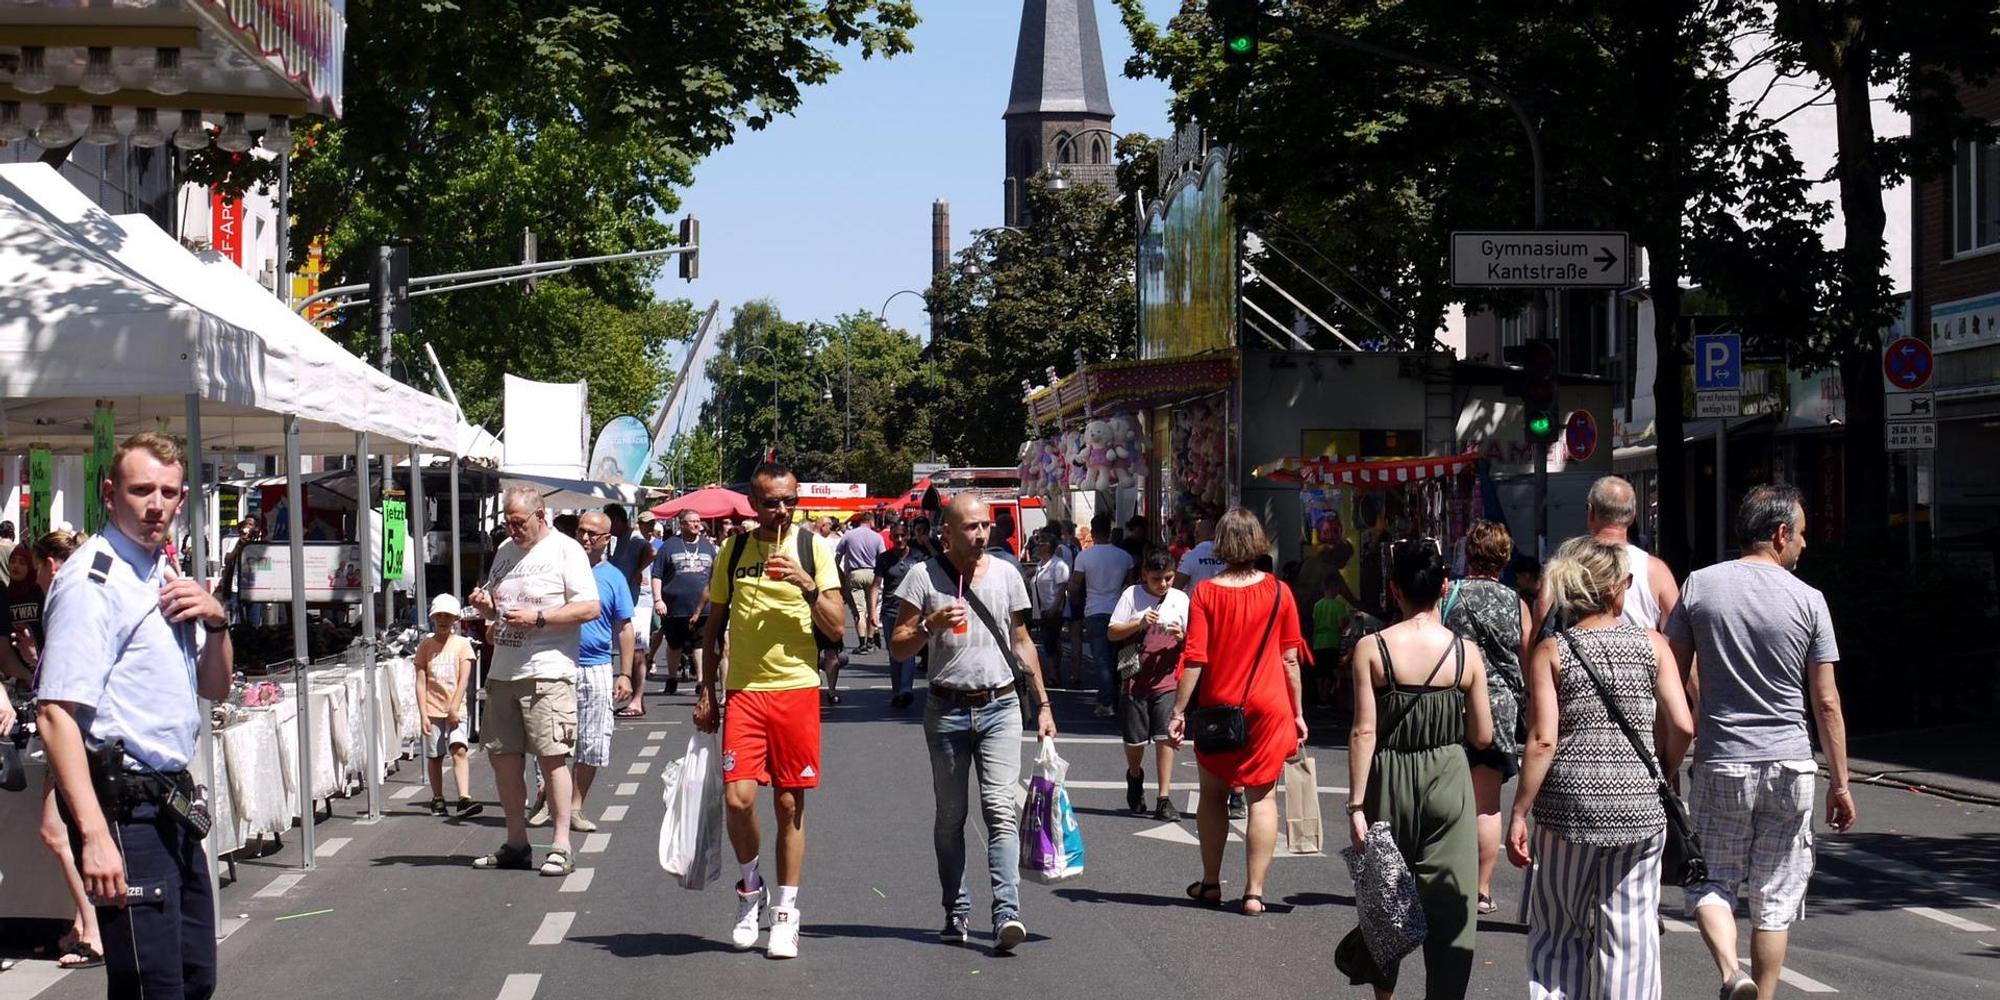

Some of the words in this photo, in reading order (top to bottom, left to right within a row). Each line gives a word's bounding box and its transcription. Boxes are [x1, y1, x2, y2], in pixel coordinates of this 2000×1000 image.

[1481, 240, 1588, 259] Gymnasium
[1488, 263, 1588, 279] Kantstraße
[1705, 342, 1729, 382] P
[811, 484, 831, 495] früh
[386, 505, 404, 522] jetzt
[736, 561, 764, 578] adi
[11, 605, 38, 619] YWAY
